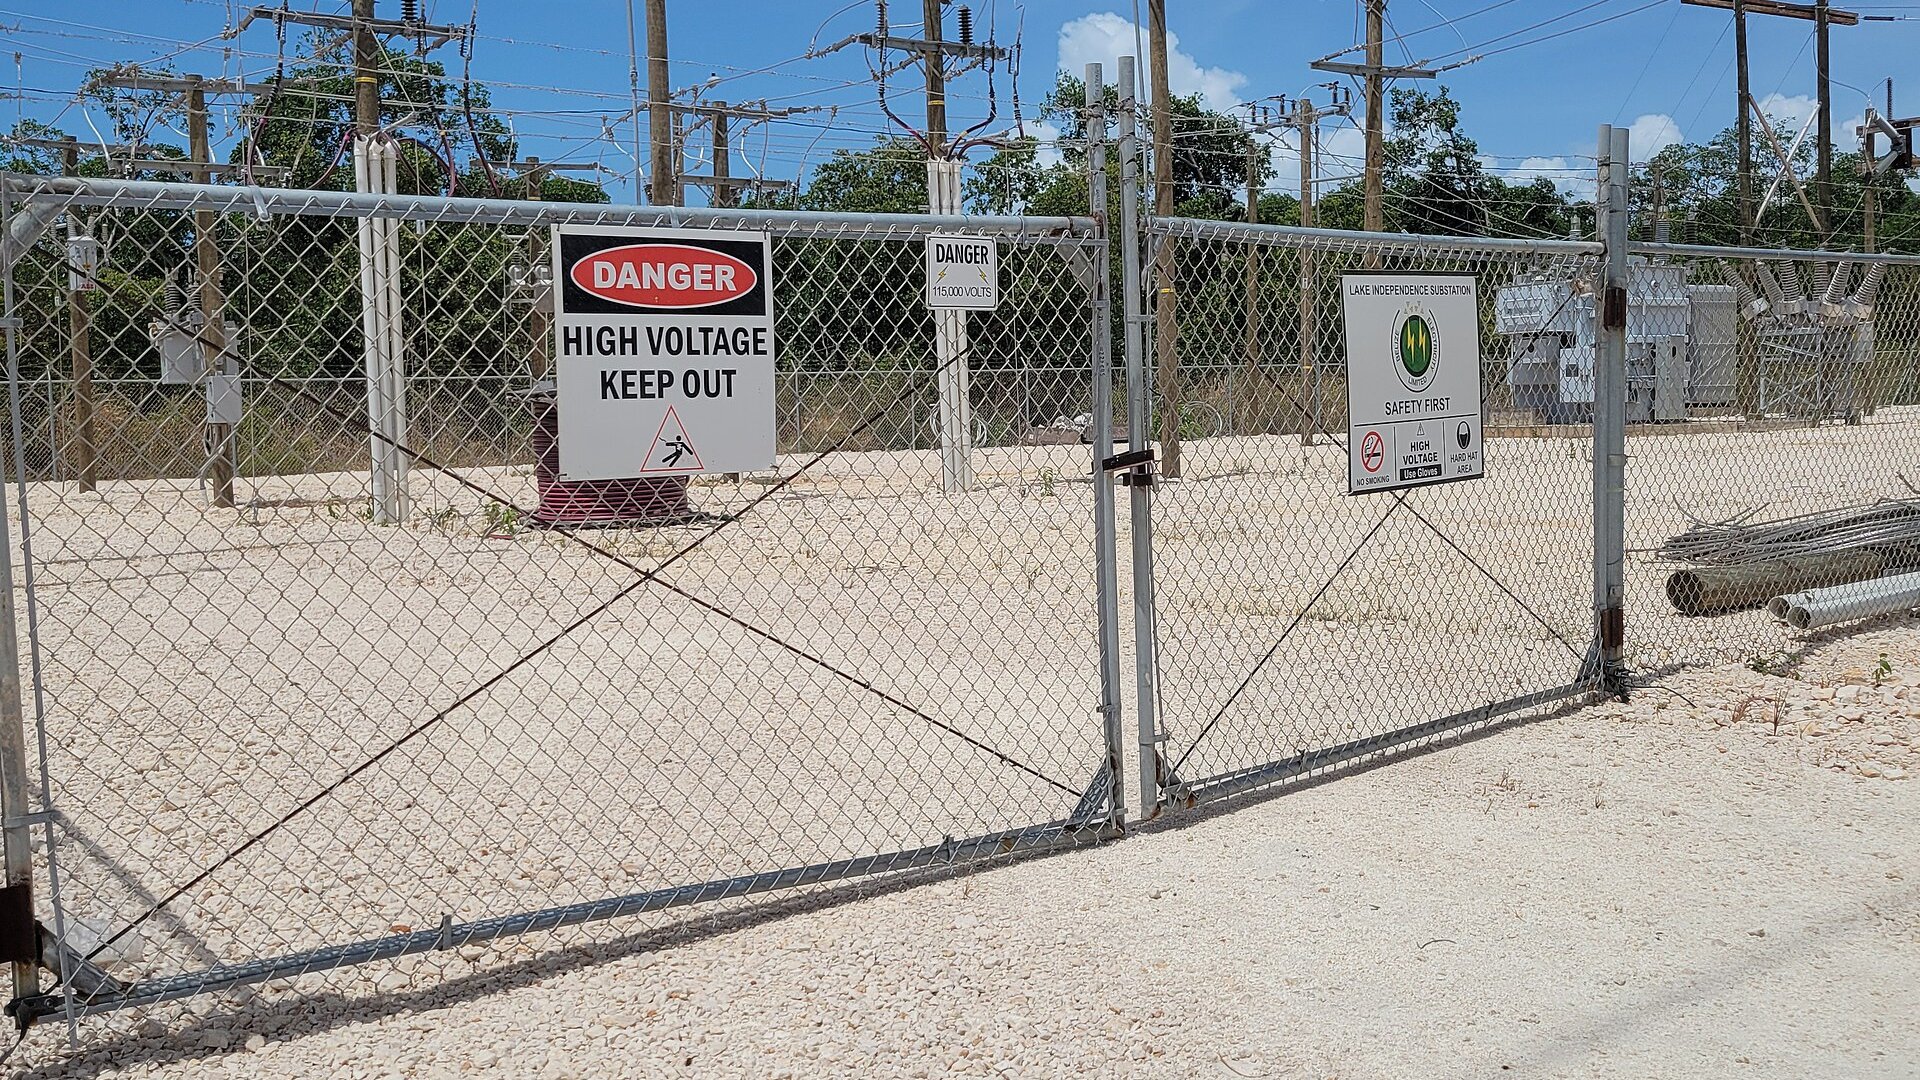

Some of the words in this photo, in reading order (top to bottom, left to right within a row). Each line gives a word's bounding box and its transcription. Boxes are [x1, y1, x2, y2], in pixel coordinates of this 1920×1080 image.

[936, 244, 989, 265] DANGER
[594, 262, 737, 291] DANGER
[933, 286, 963, 298] 115,000
[964, 287, 992, 297] VOLTS
[1349, 285, 1370, 295] LAKE
[1372, 285, 1429, 295] INDEPENDENCE
[1430, 285, 1471, 295] SUBSTATION
[563, 326, 638, 356] HIGH
[646, 326, 768, 356] VOLTAGE
[1427, 317, 1438, 371] ELECTRICITY
[601, 370, 675, 400] KEEP
[683, 370, 737, 398] OUT
[1408, 376, 1427, 386] LIMITED
[1385, 400, 1422, 416] SAFETY
[1425, 397, 1450, 413] FIRST
[1411, 441, 1430, 452] HIGH
[1403, 452, 1438, 465] VOLTAGE
[1451, 453, 1467, 463] HARD
[1468, 452, 1478, 461] HAT
[1404, 469, 1417, 479] Use
[1418, 467, 1438, 478] Gloves
[1457, 465, 1472, 474] AREA
[1357, 478, 1364, 486] NO
[1366, 475, 1389, 485] SMOKING
